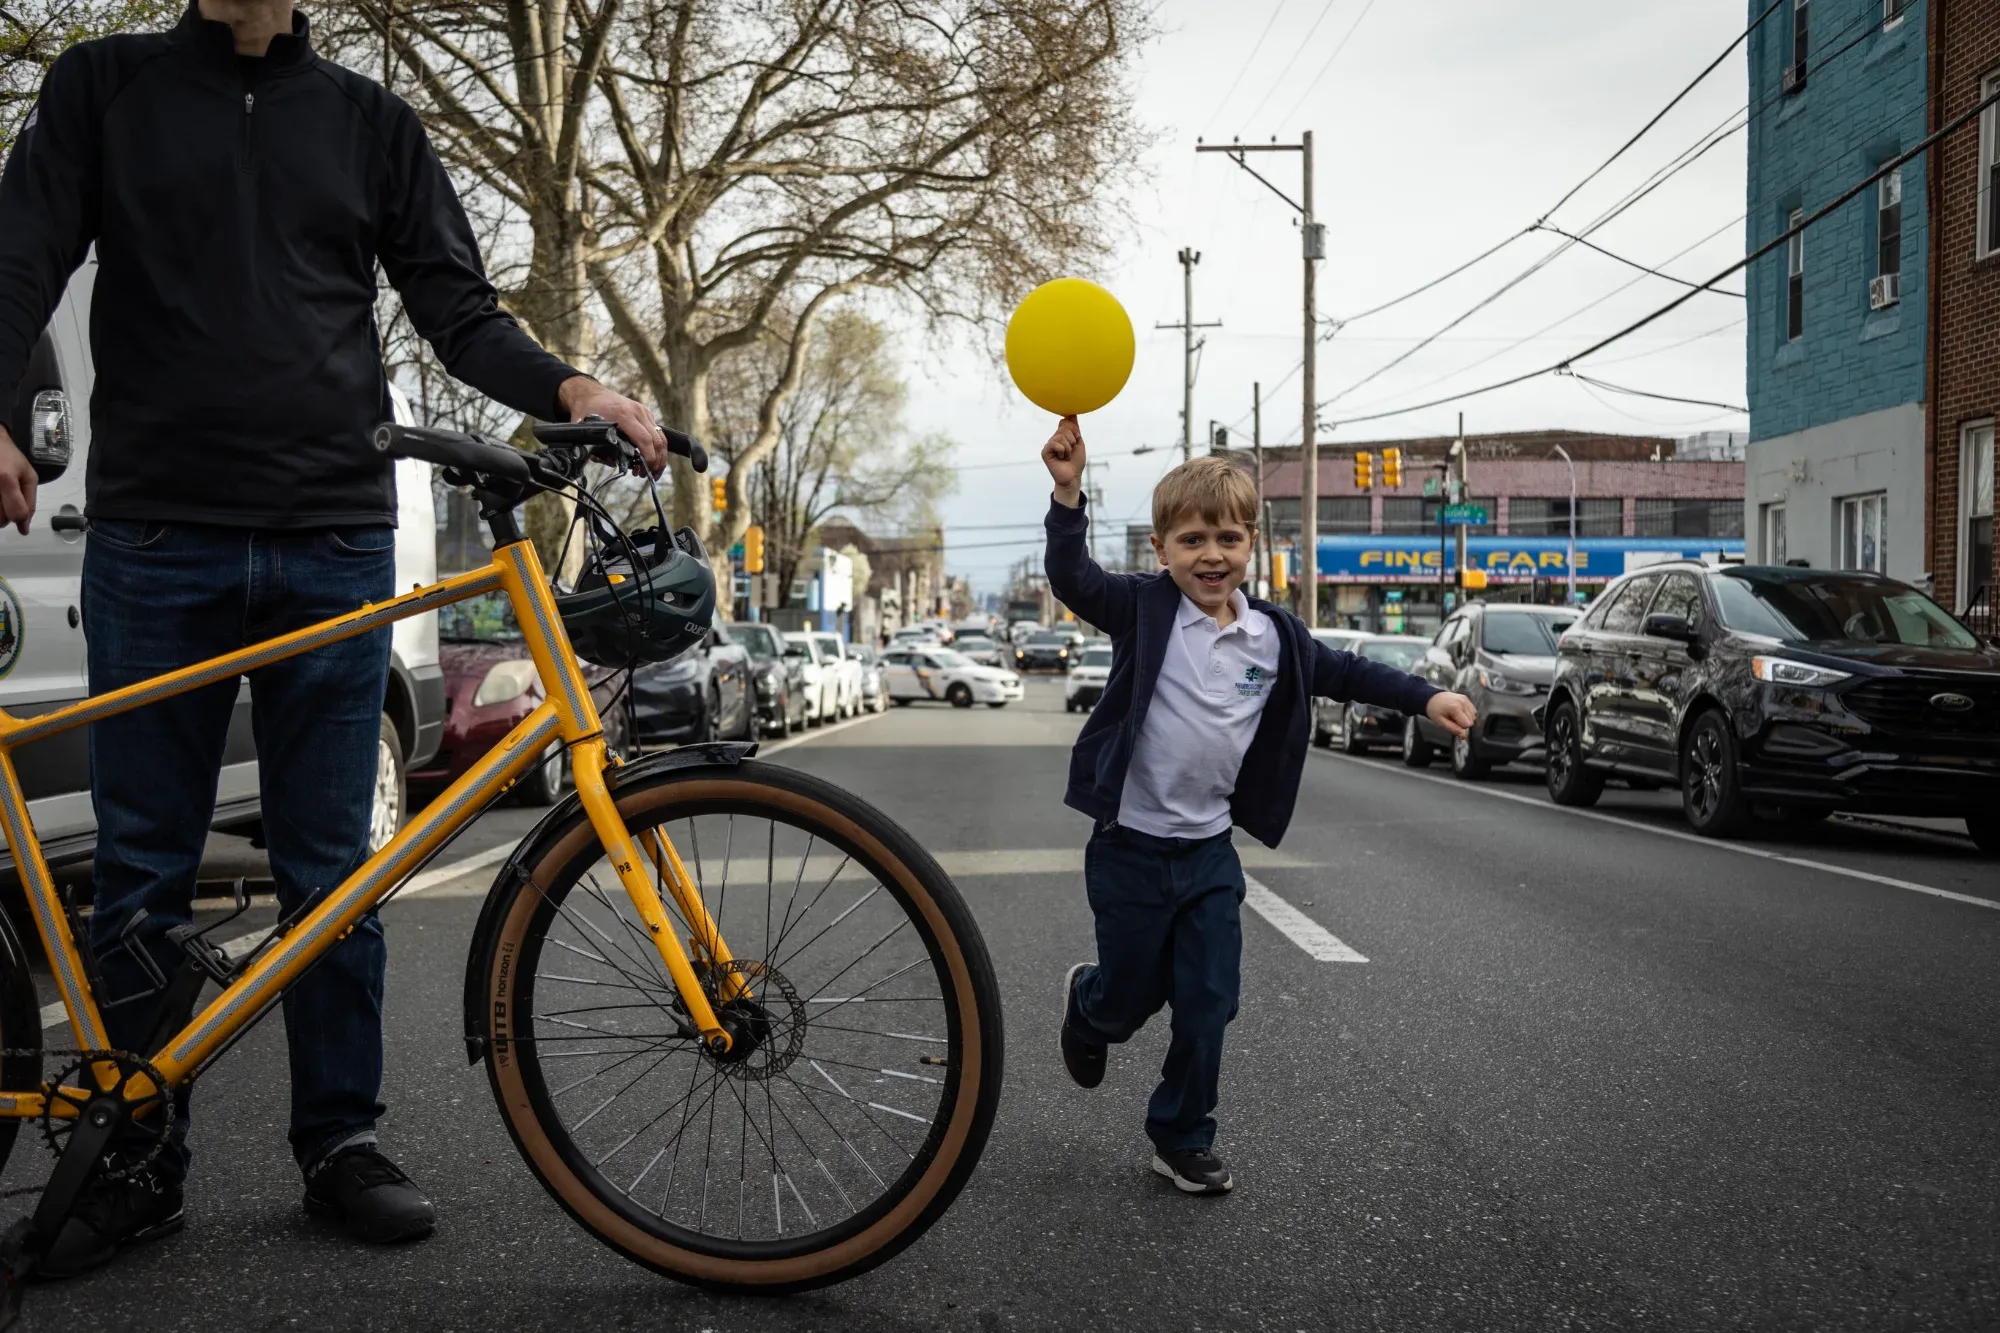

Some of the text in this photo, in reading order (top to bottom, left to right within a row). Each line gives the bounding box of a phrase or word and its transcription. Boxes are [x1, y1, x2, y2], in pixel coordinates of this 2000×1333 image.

[1359, 551, 1589, 568] FINE FARE
[496, 954, 511, 998] horizon
